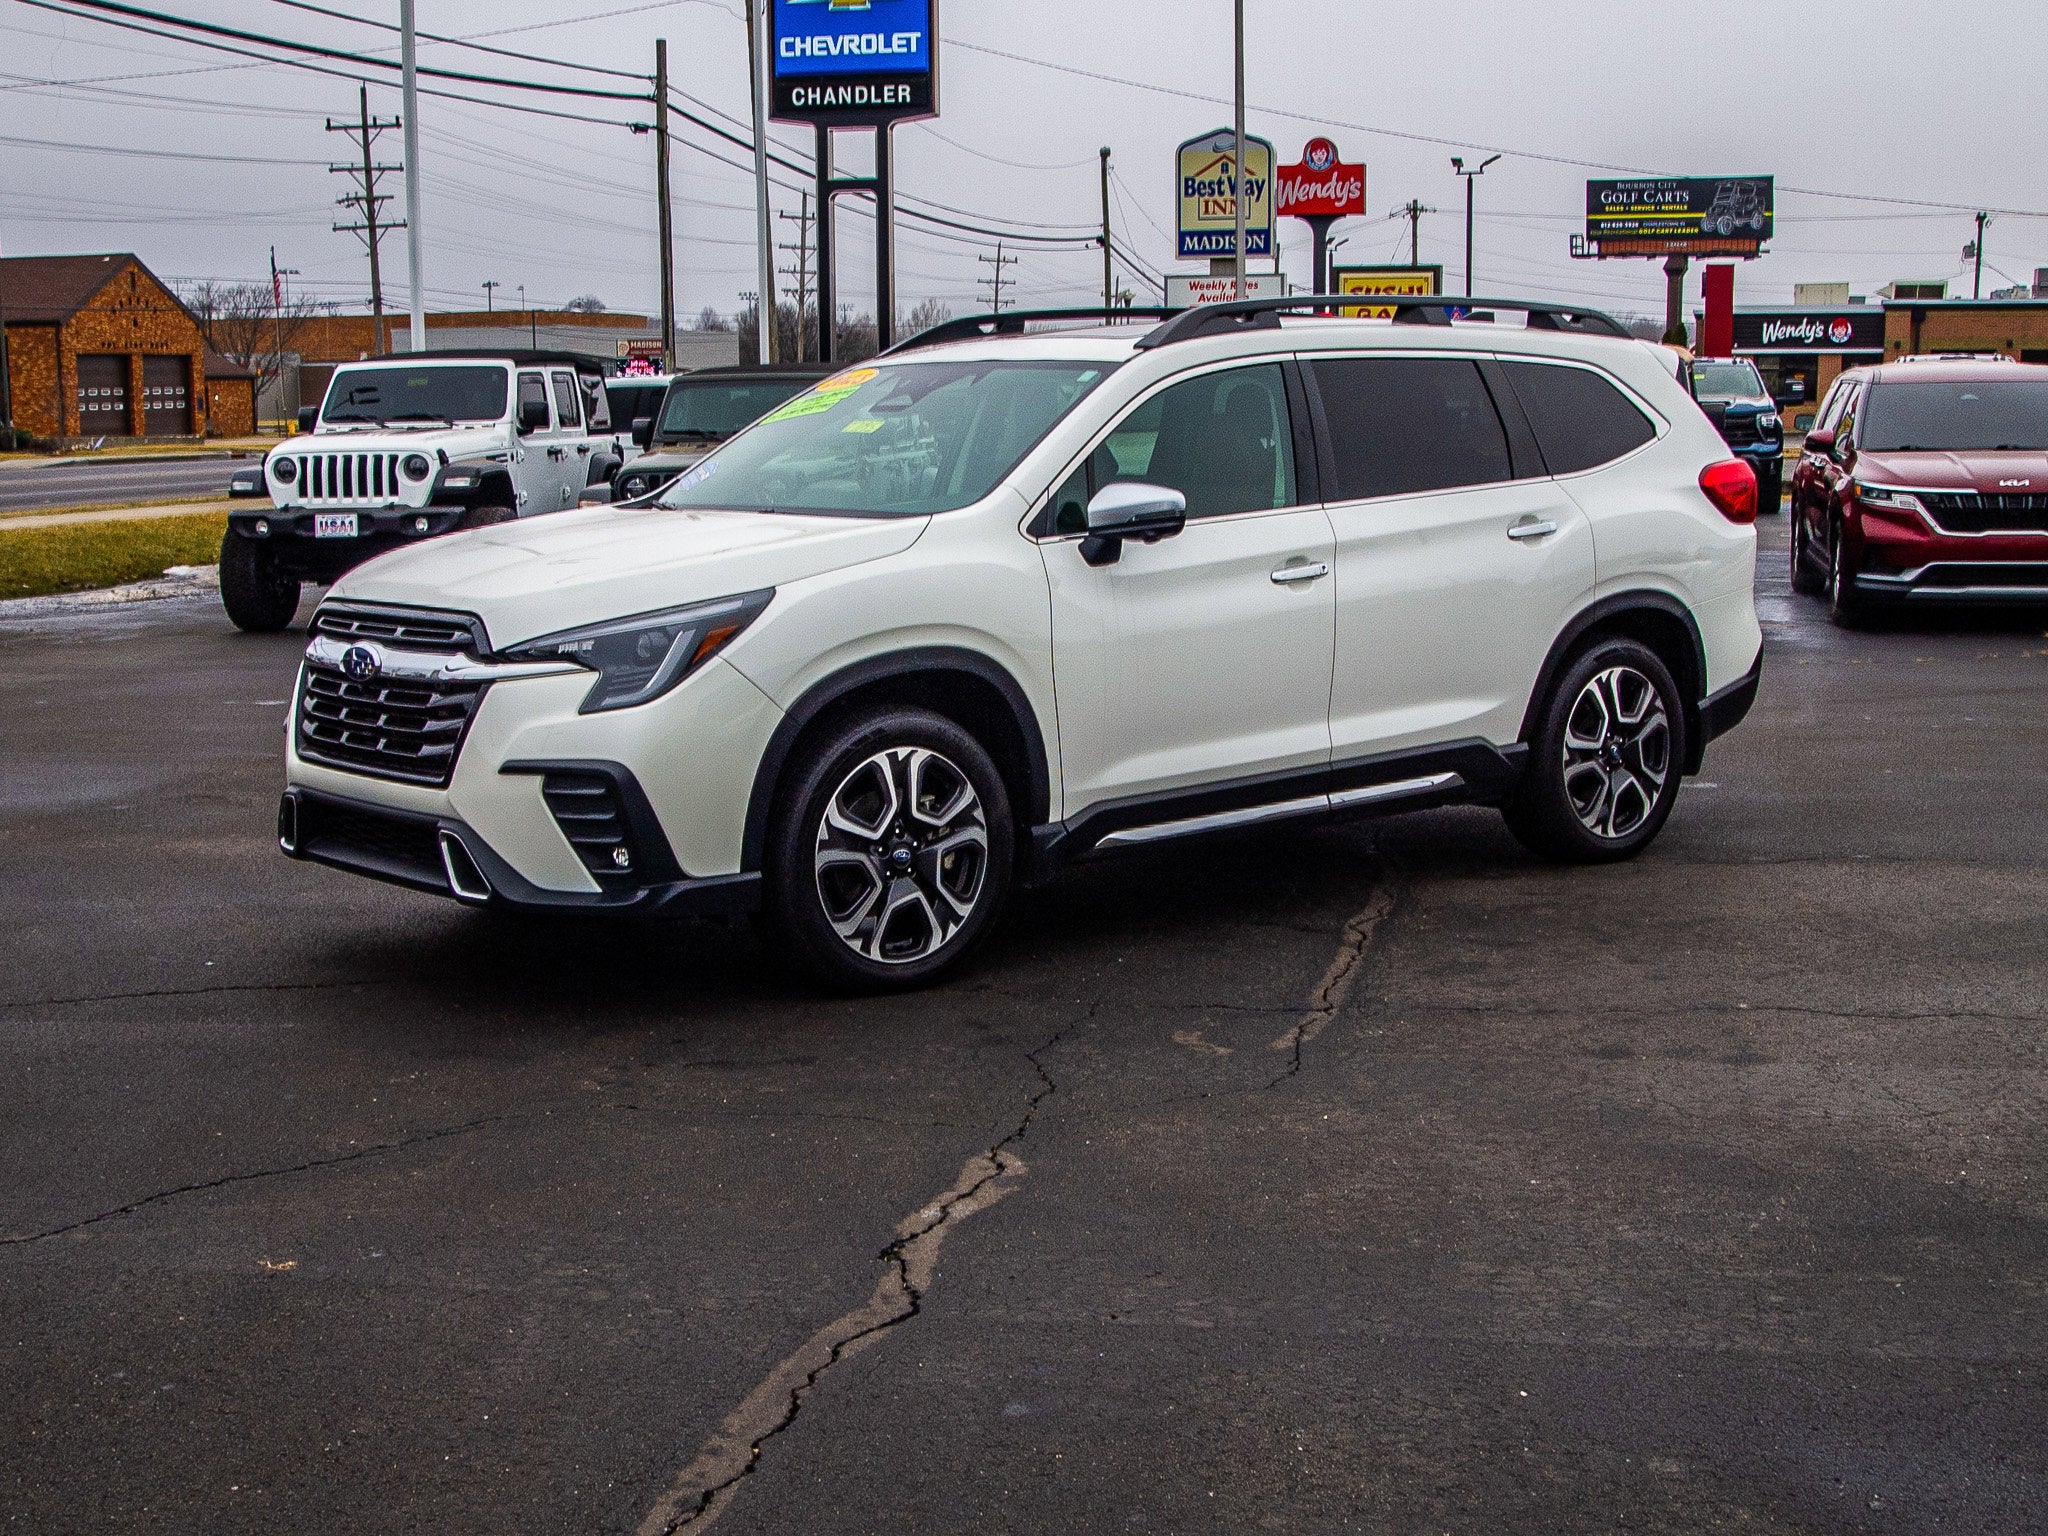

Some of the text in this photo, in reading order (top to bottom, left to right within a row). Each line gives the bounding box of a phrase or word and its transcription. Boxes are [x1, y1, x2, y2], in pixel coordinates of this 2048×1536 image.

[780, 32, 921, 58] CHEVROLET
[792, 84, 911, 106] CHANDLER
[1277, 171, 1361, 208] Wendy's
[1658, 181, 1678, 189] CITY
[1600, 189, 1690, 204] GOLF CARTS
[1630, 204, 1656, 212] SERVICE
[1188, 280, 1259, 292] Weekly Res
[1762, 317, 1825, 344] Wendy's
[630, 341, 662, 349] MADISON
[319, 520, 354, 533] USA1
